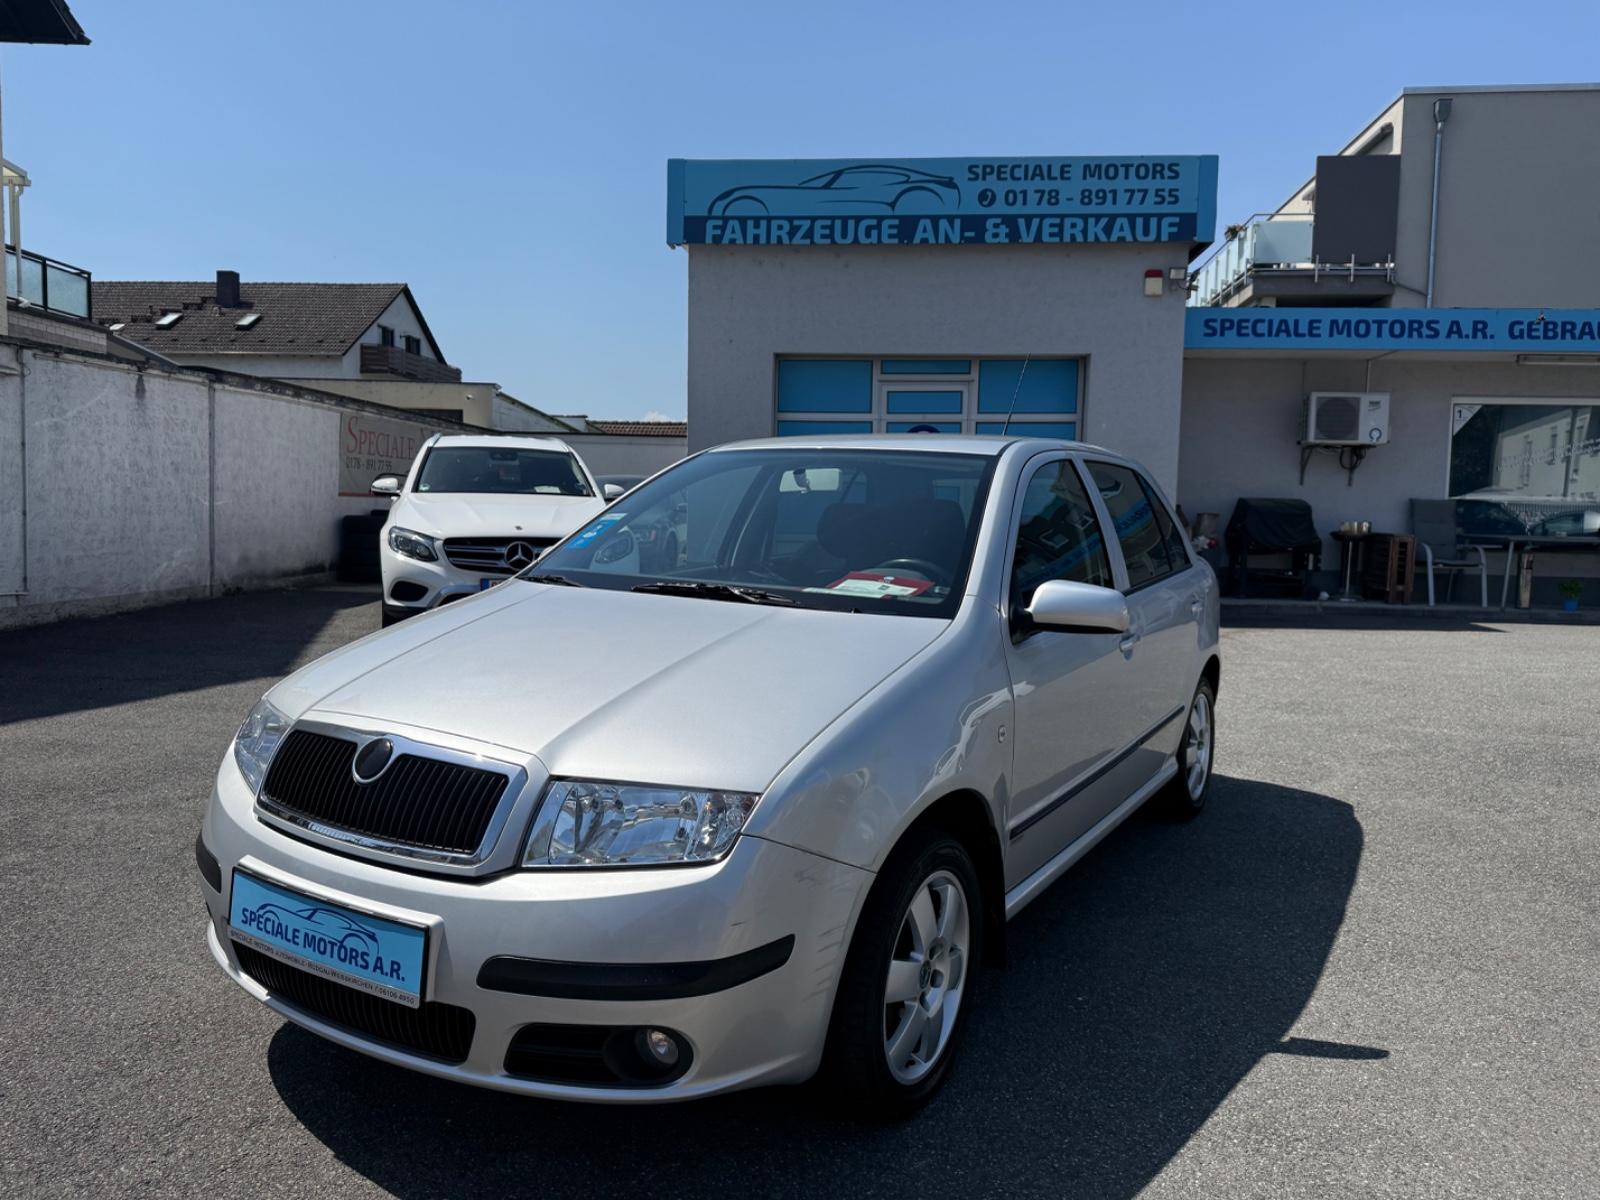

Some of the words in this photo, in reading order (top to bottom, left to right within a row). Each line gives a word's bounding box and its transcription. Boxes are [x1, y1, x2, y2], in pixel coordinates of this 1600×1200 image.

[967, 163, 1072, 182] SPECIALE
[1082, 162, 1180, 181] MOTORS
[1004, 188, 1060, 207] 0178
[704, 218, 900, 245] FAHRZEUGE
[912, 217, 975, 244] AN-
[984, 216, 1010, 243] &
[1017, 215, 1181, 243] VERKAUF
[1203, 318, 1323, 338] SPECIALE
[1328, 318, 1440, 339] MOTORS
[1445, 319, 1496, 340] A.R.
[1508, 319, 1600, 341] GEBRA
[241, 907, 300, 946] SPECIALE
[303, 931, 370, 970] MOTORS
[372, 956, 406, 982] A.R.
